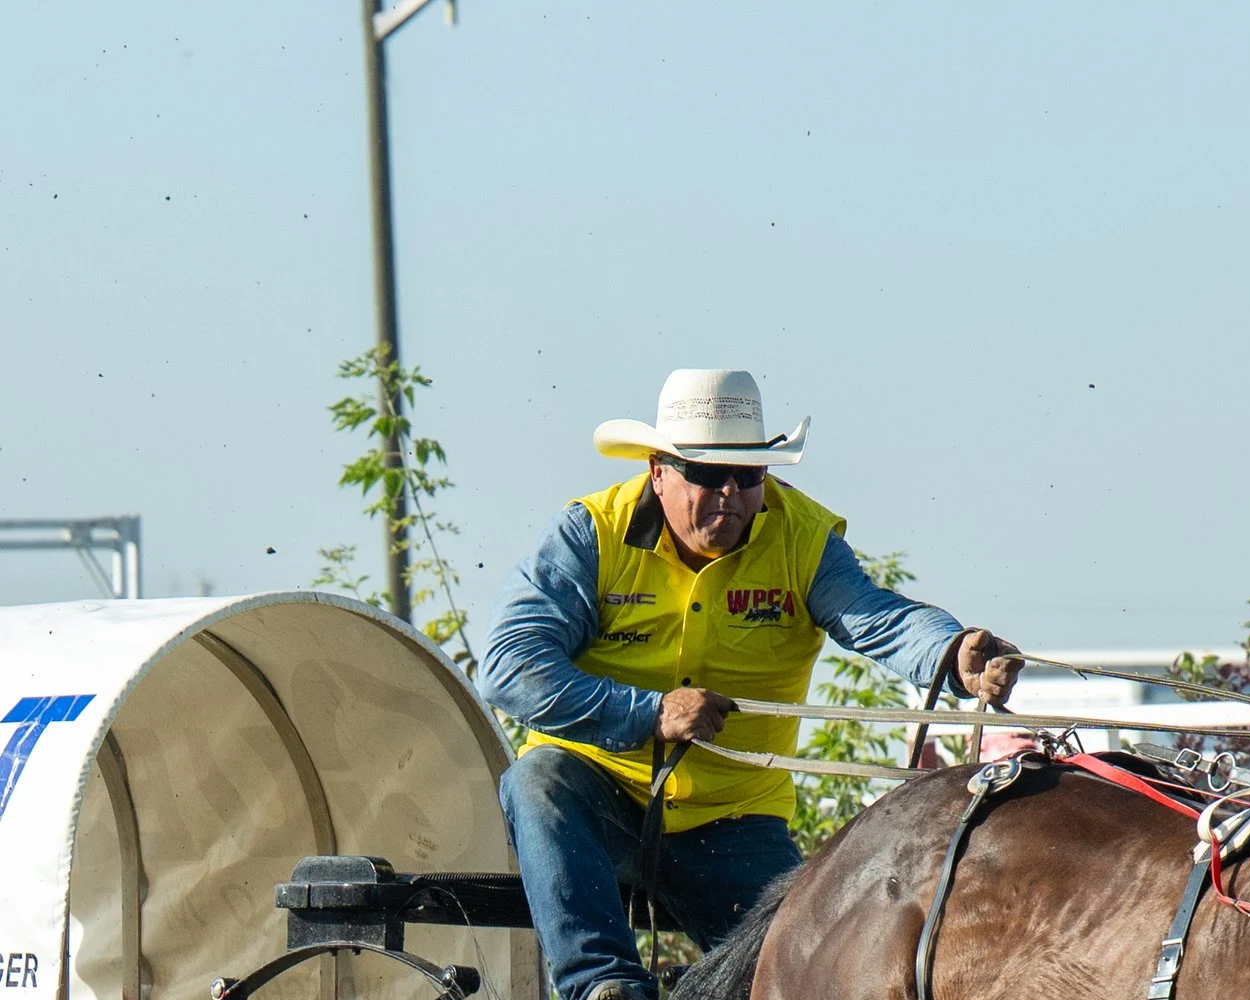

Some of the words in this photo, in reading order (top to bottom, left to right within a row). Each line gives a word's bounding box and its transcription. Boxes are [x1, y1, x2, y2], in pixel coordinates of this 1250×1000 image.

[605, 592, 656, 605] GMC
[726, 588, 796, 616] WPCA
[0, 953, 38, 988] ER
